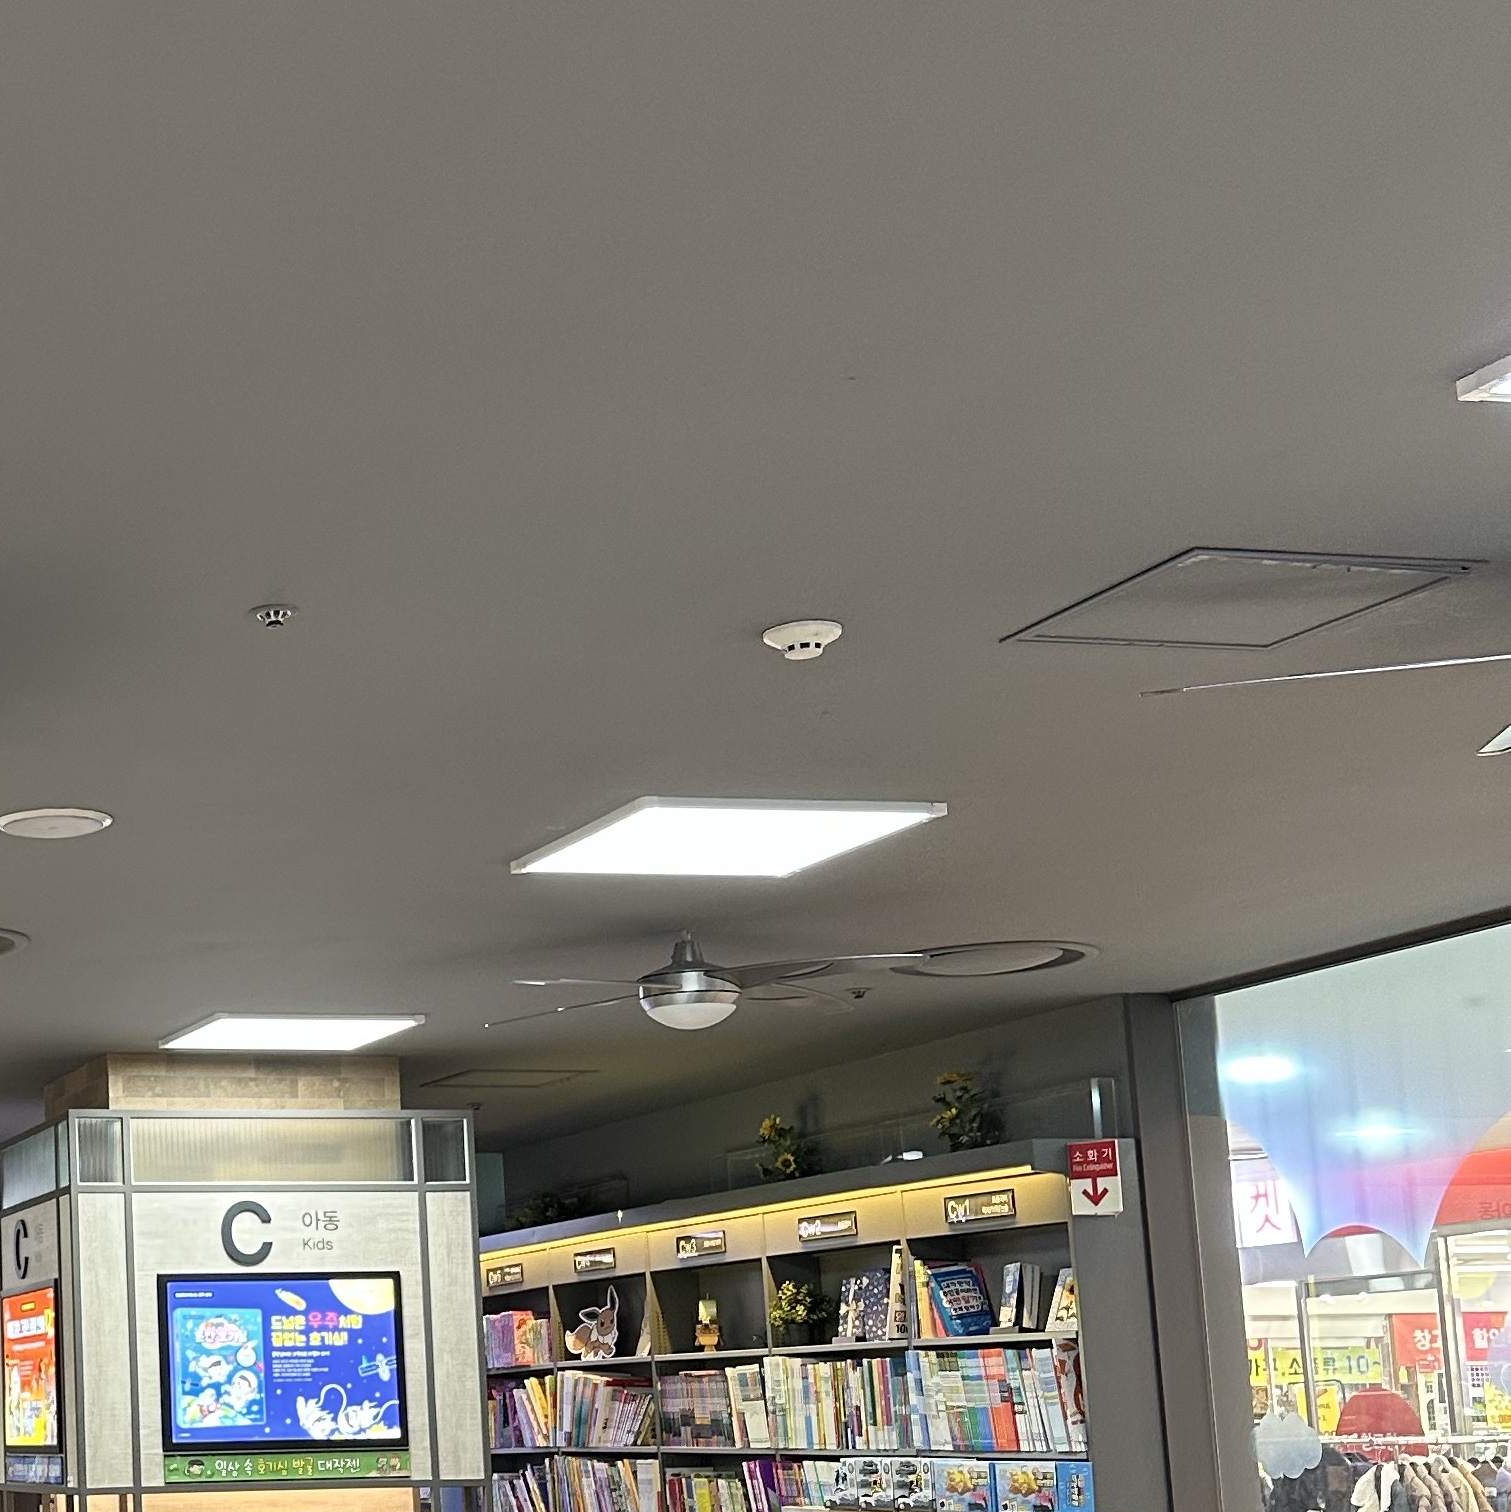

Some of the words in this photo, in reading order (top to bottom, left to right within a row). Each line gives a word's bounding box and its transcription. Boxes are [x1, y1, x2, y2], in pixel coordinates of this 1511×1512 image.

[301, 1209, 340, 1232] 아동
[221, 1201, 274, 1267] C
[302, 1237, 334, 1252] Kids
[215, 1459, 240, 1477] 일상
[256, 1458, 288, 1476] 호기심
[292, 1457, 314, 1476] 발굴
